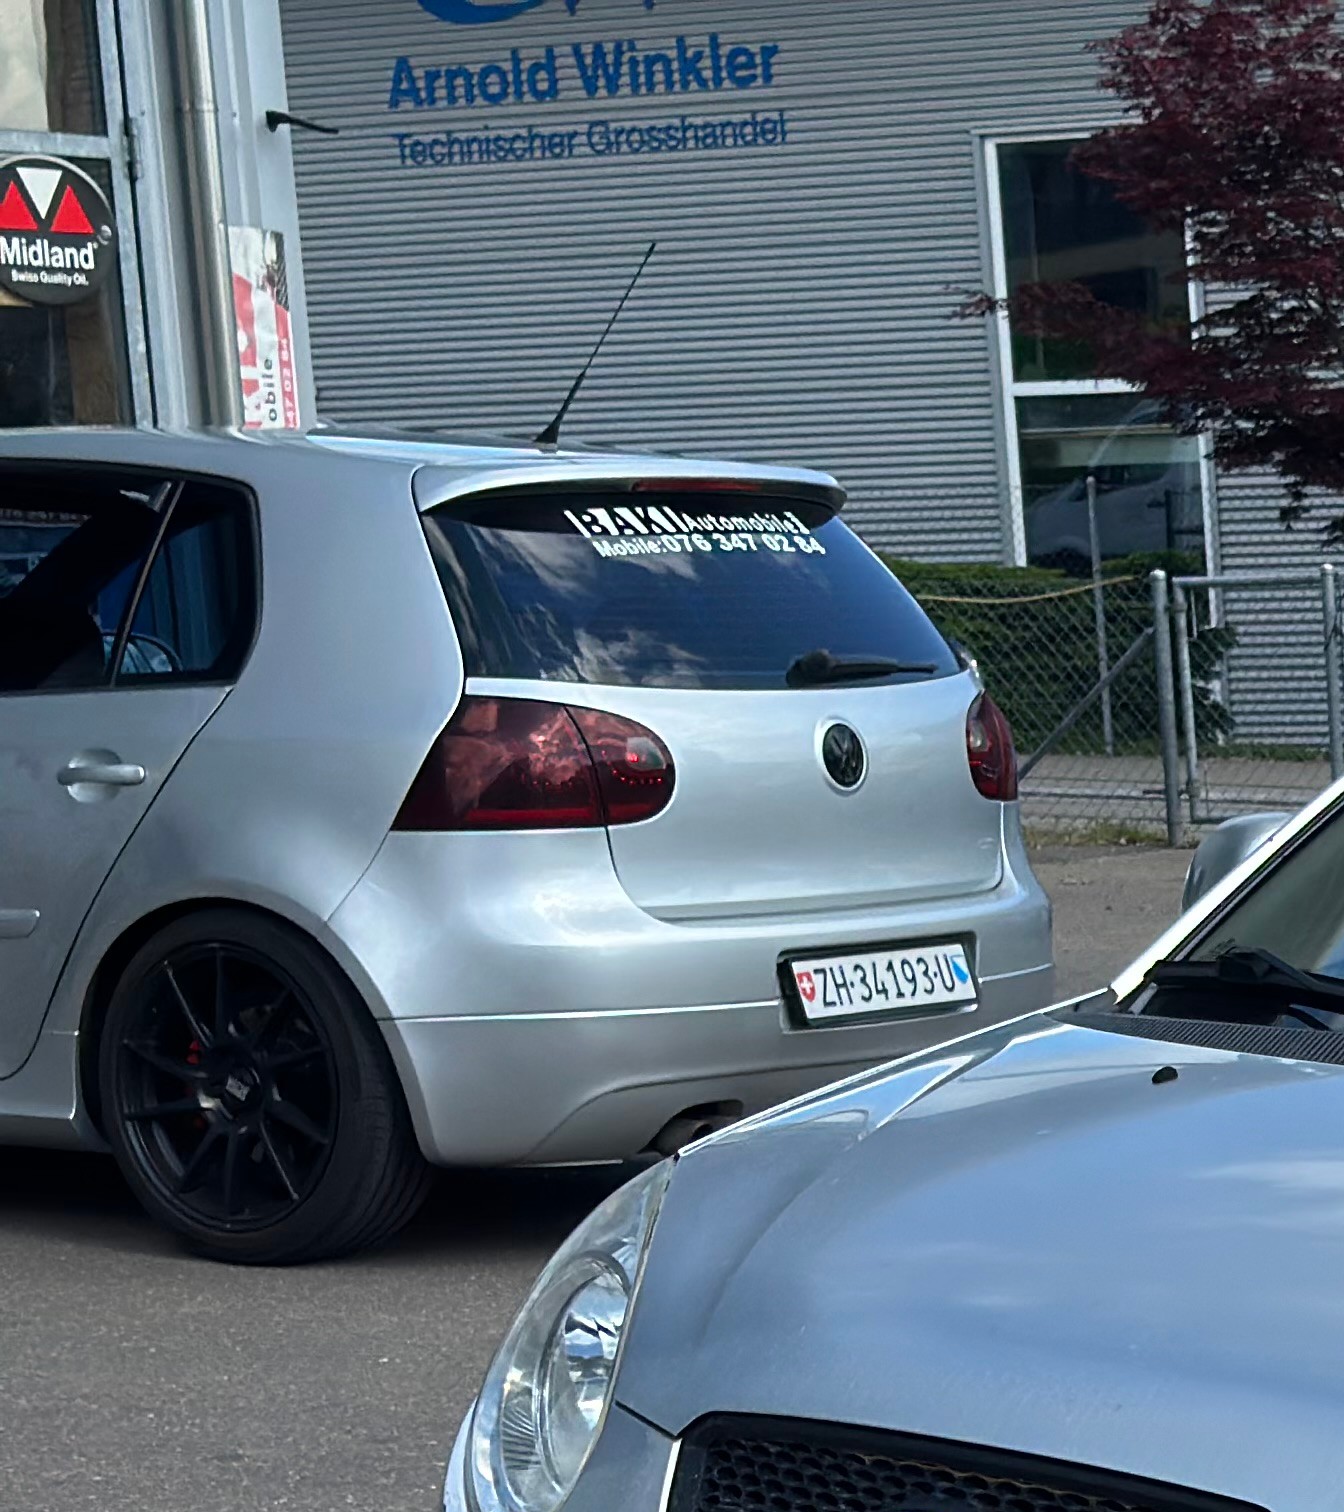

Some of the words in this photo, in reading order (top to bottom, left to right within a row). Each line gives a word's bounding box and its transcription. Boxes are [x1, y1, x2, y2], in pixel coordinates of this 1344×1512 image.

[388, 46, 560, 109] Arnold
[571, 33, 780, 97] Winkler
[395, 126, 580, 166] Technischer
[587, 110, 789, 155] Grosshandel
[0, 235, 95, 270] Midland
[40, 271, 72, 287] Quality
[713, 533, 757, 552] 347
[763, 533, 796, 554] 02
[795, 535, 826, 555] 84
